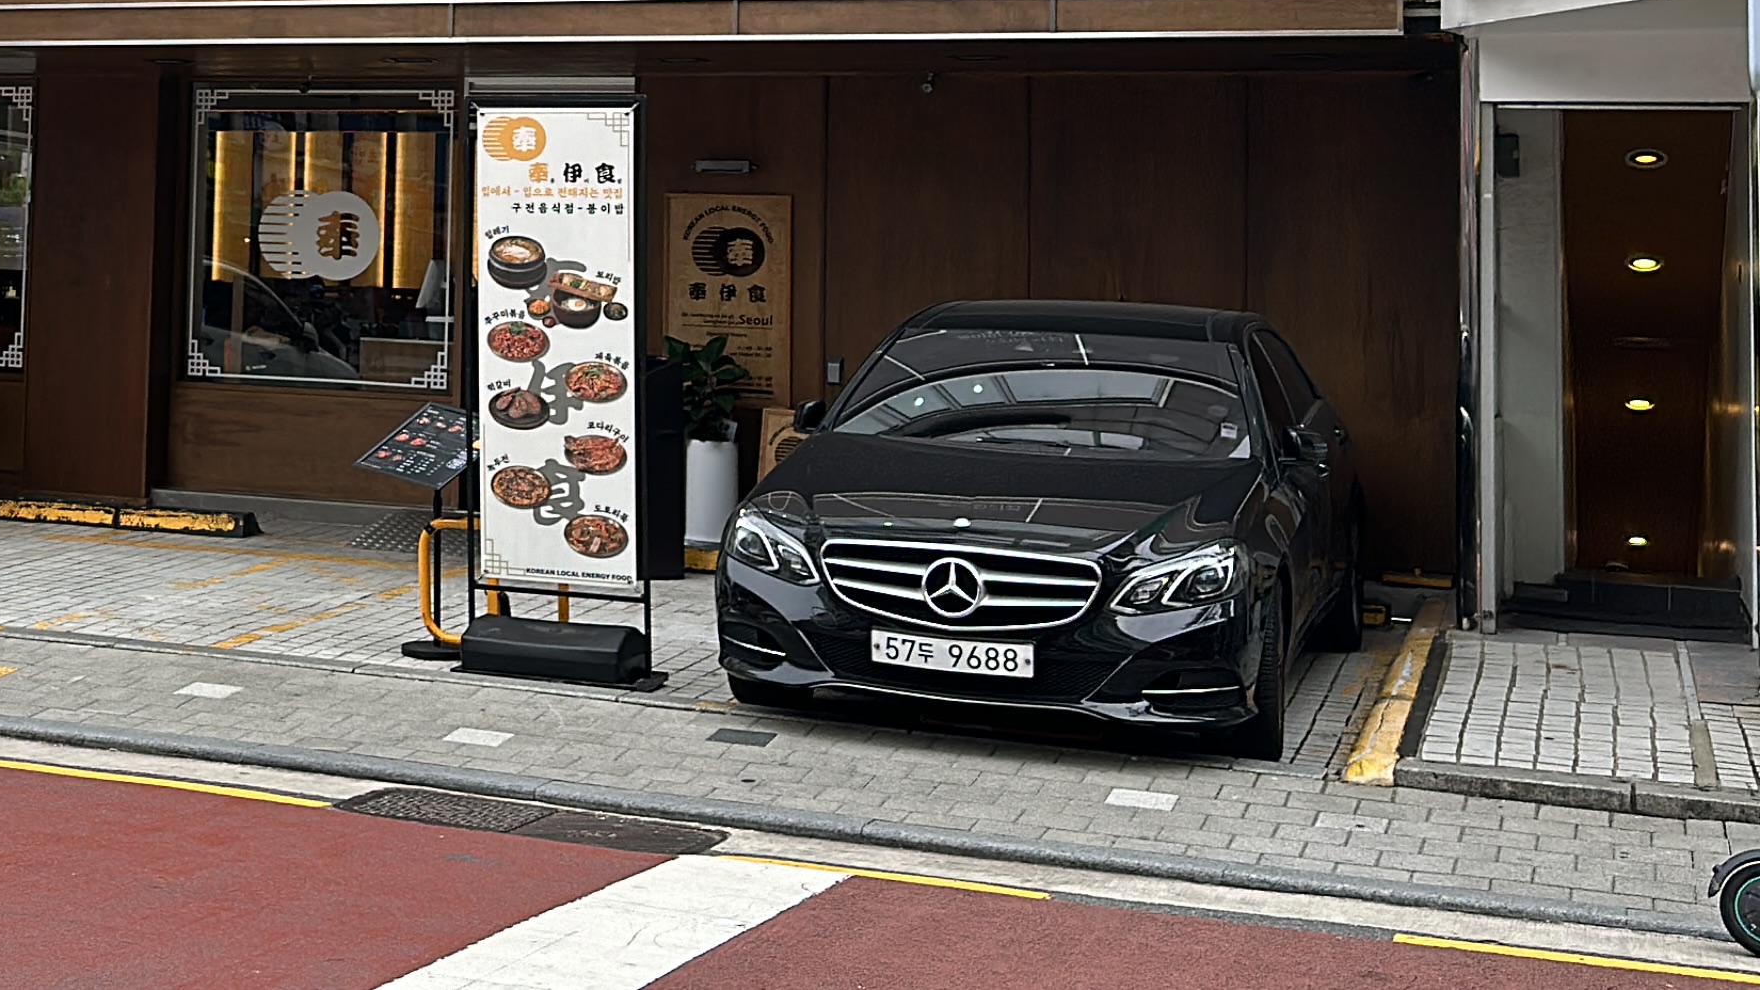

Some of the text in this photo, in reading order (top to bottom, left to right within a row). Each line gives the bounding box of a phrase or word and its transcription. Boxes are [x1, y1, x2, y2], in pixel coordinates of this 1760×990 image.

[704, 204, 731, 217] LOCAL
[738, 314, 774, 327] Seoul
[526, 568, 560, 576] KOREAN
[560, 570, 580, 578] LOCAL
[581, 572, 611, 580] ENERGY
[885, 636, 1019, 673] 57두 9688
